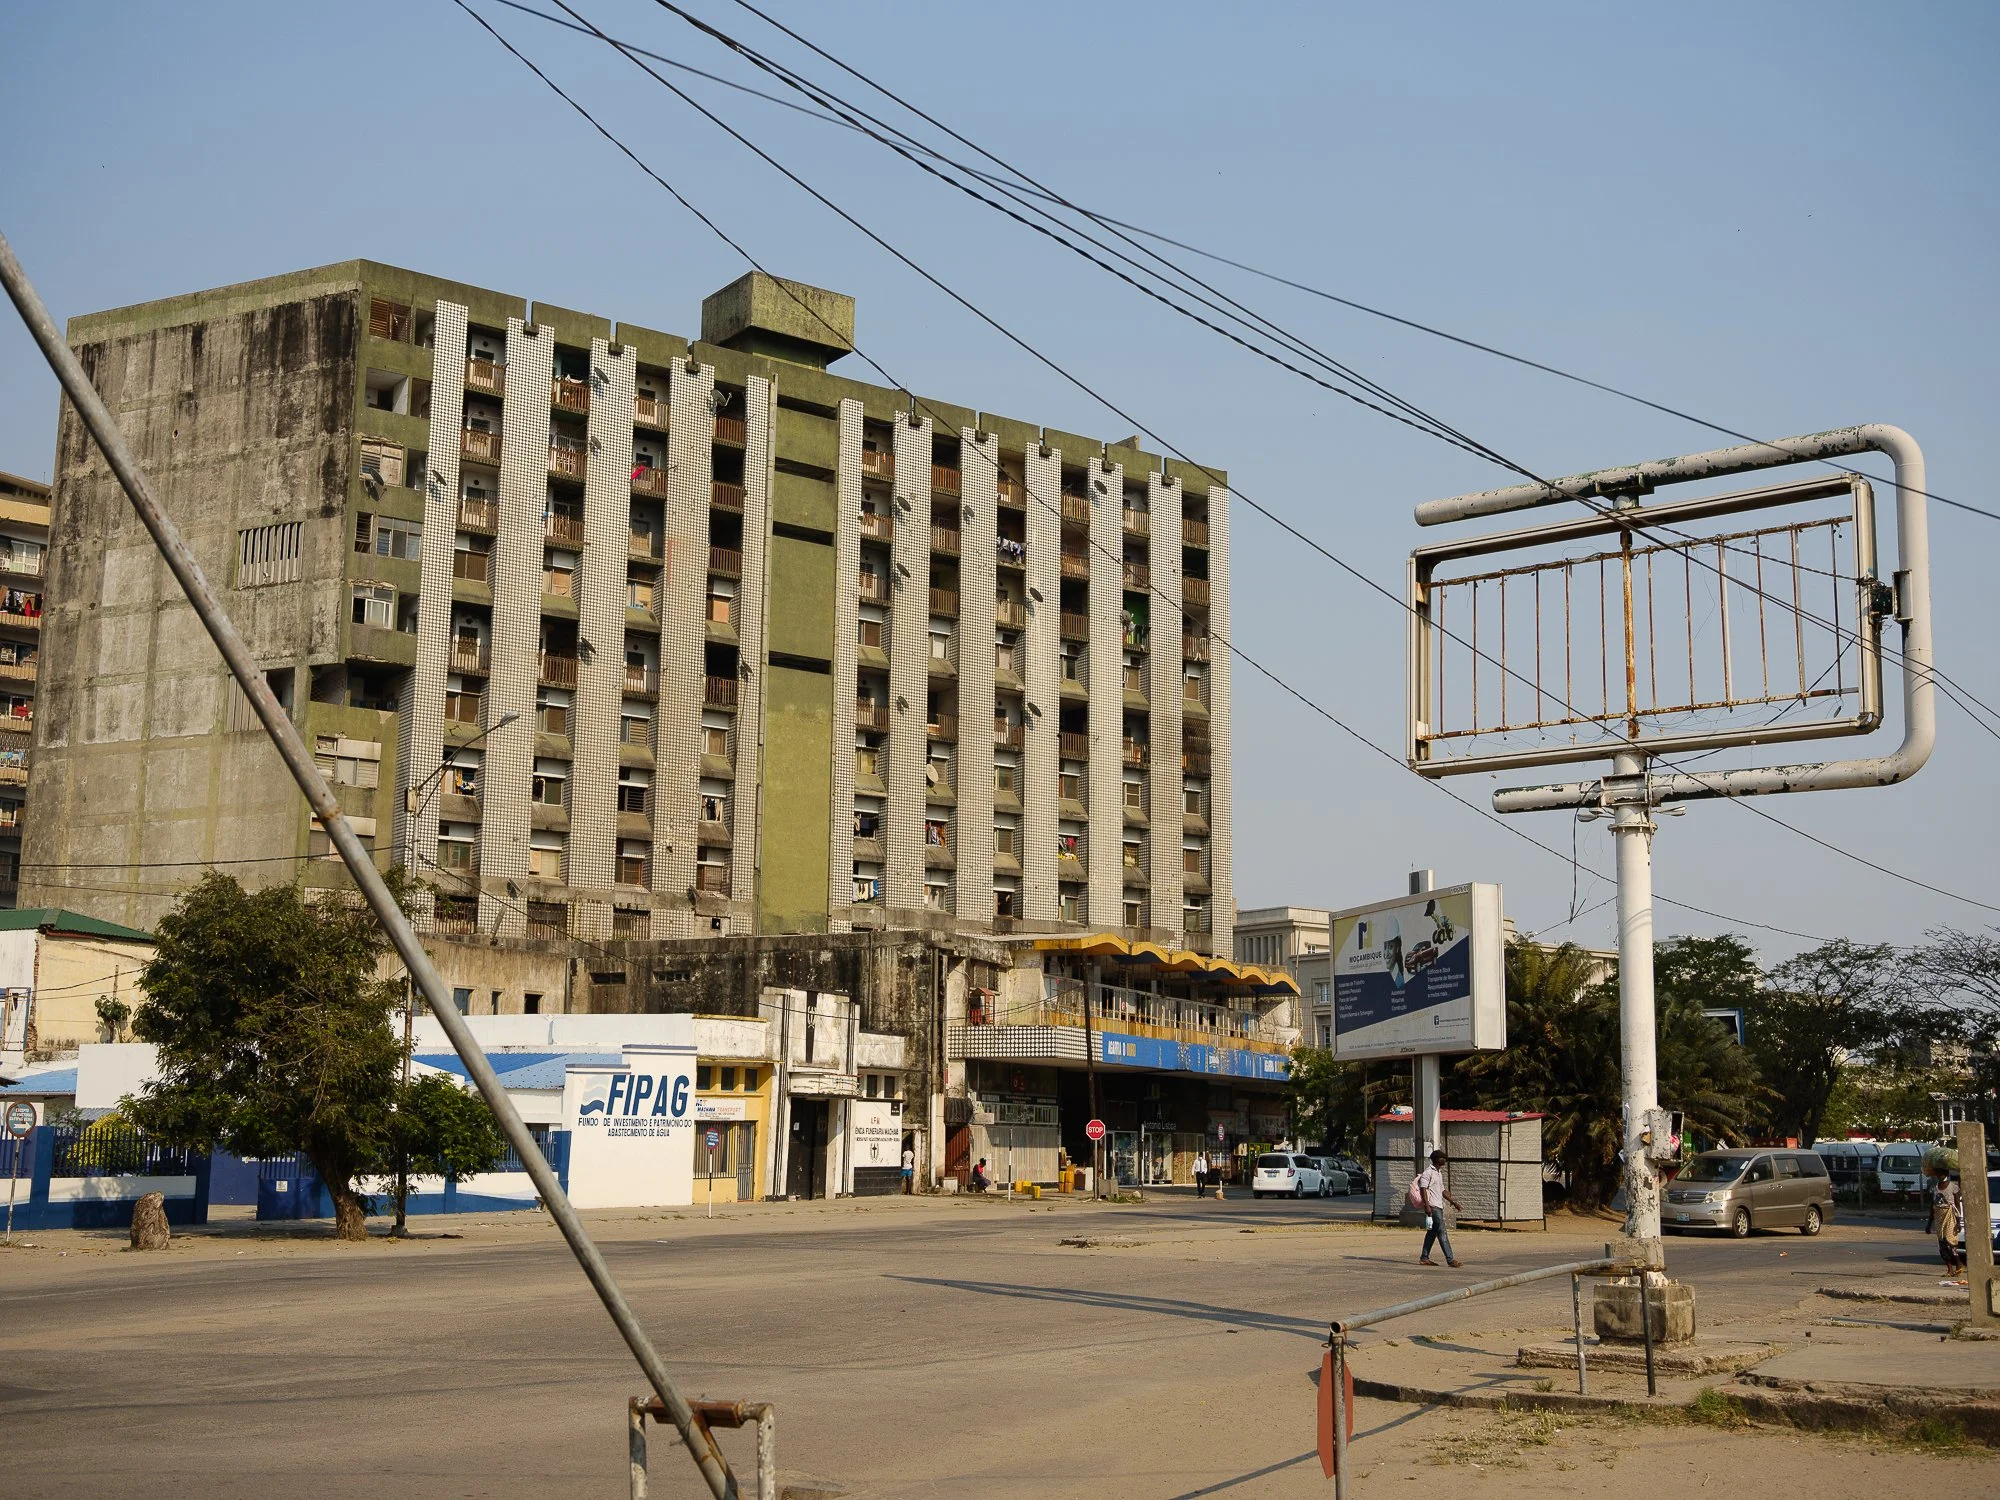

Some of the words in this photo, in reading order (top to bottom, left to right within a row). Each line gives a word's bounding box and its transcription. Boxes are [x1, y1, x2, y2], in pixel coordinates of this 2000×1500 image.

[1349, 951, 1382, 963] MOÇAMBIQUE
[606, 1074, 690, 1118] FIPAG
[578, 1118, 599, 1126] FUNDO
[603, 1118, 610, 1127] DE
[613, 1118, 648, 1127] INVESTIMENTO
[649, 1119, 653, 1127] E
[684, 1119, 693, 1128] DO
[607, 1128, 648, 1137] ABASTECIMENTO
[648, 1129, 655, 1137] DE
[656, 1127, 670, 1137] ÁGUA
